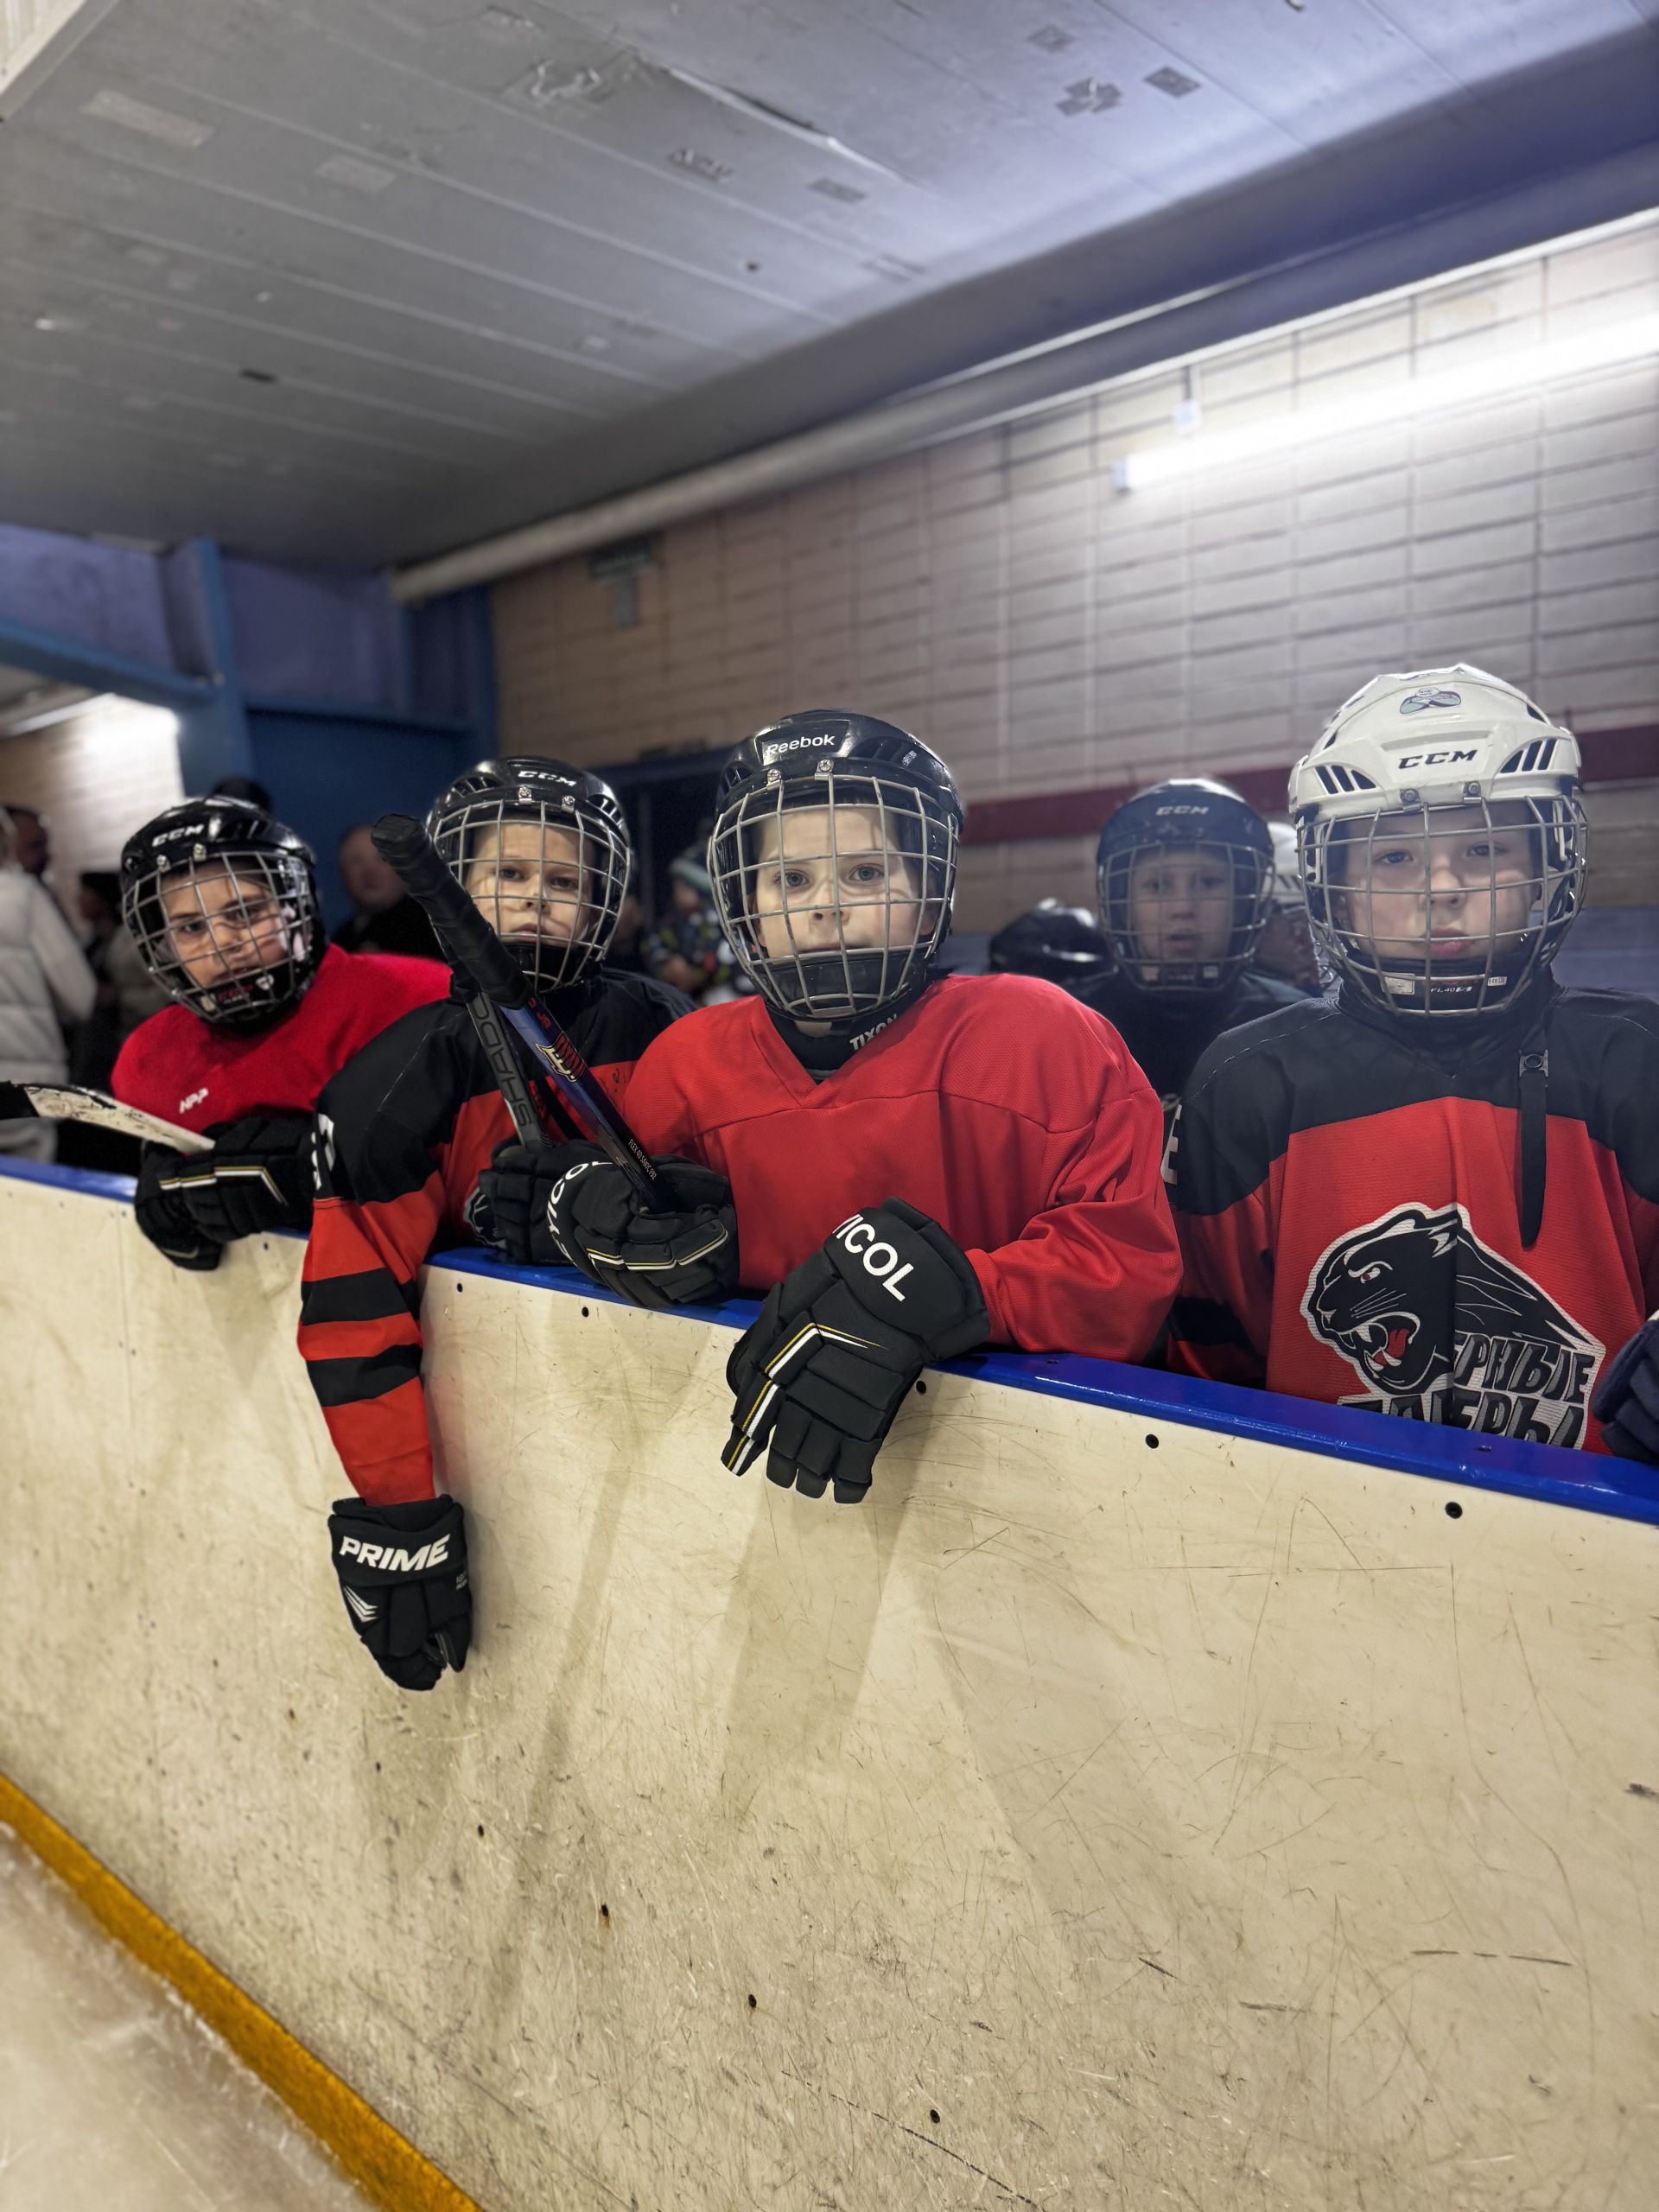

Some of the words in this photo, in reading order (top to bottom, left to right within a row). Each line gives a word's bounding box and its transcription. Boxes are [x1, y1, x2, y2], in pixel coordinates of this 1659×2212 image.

[766, 734, 836, 754] Reebok
[1398, 749, 1478, 769] CCM
[518, 771, 577, 786] CCM
[1156, 804, 1210, 816] CCM
[152, 823, 205, 848] CCM
[339, 1533, 451, 1572] PRIME
